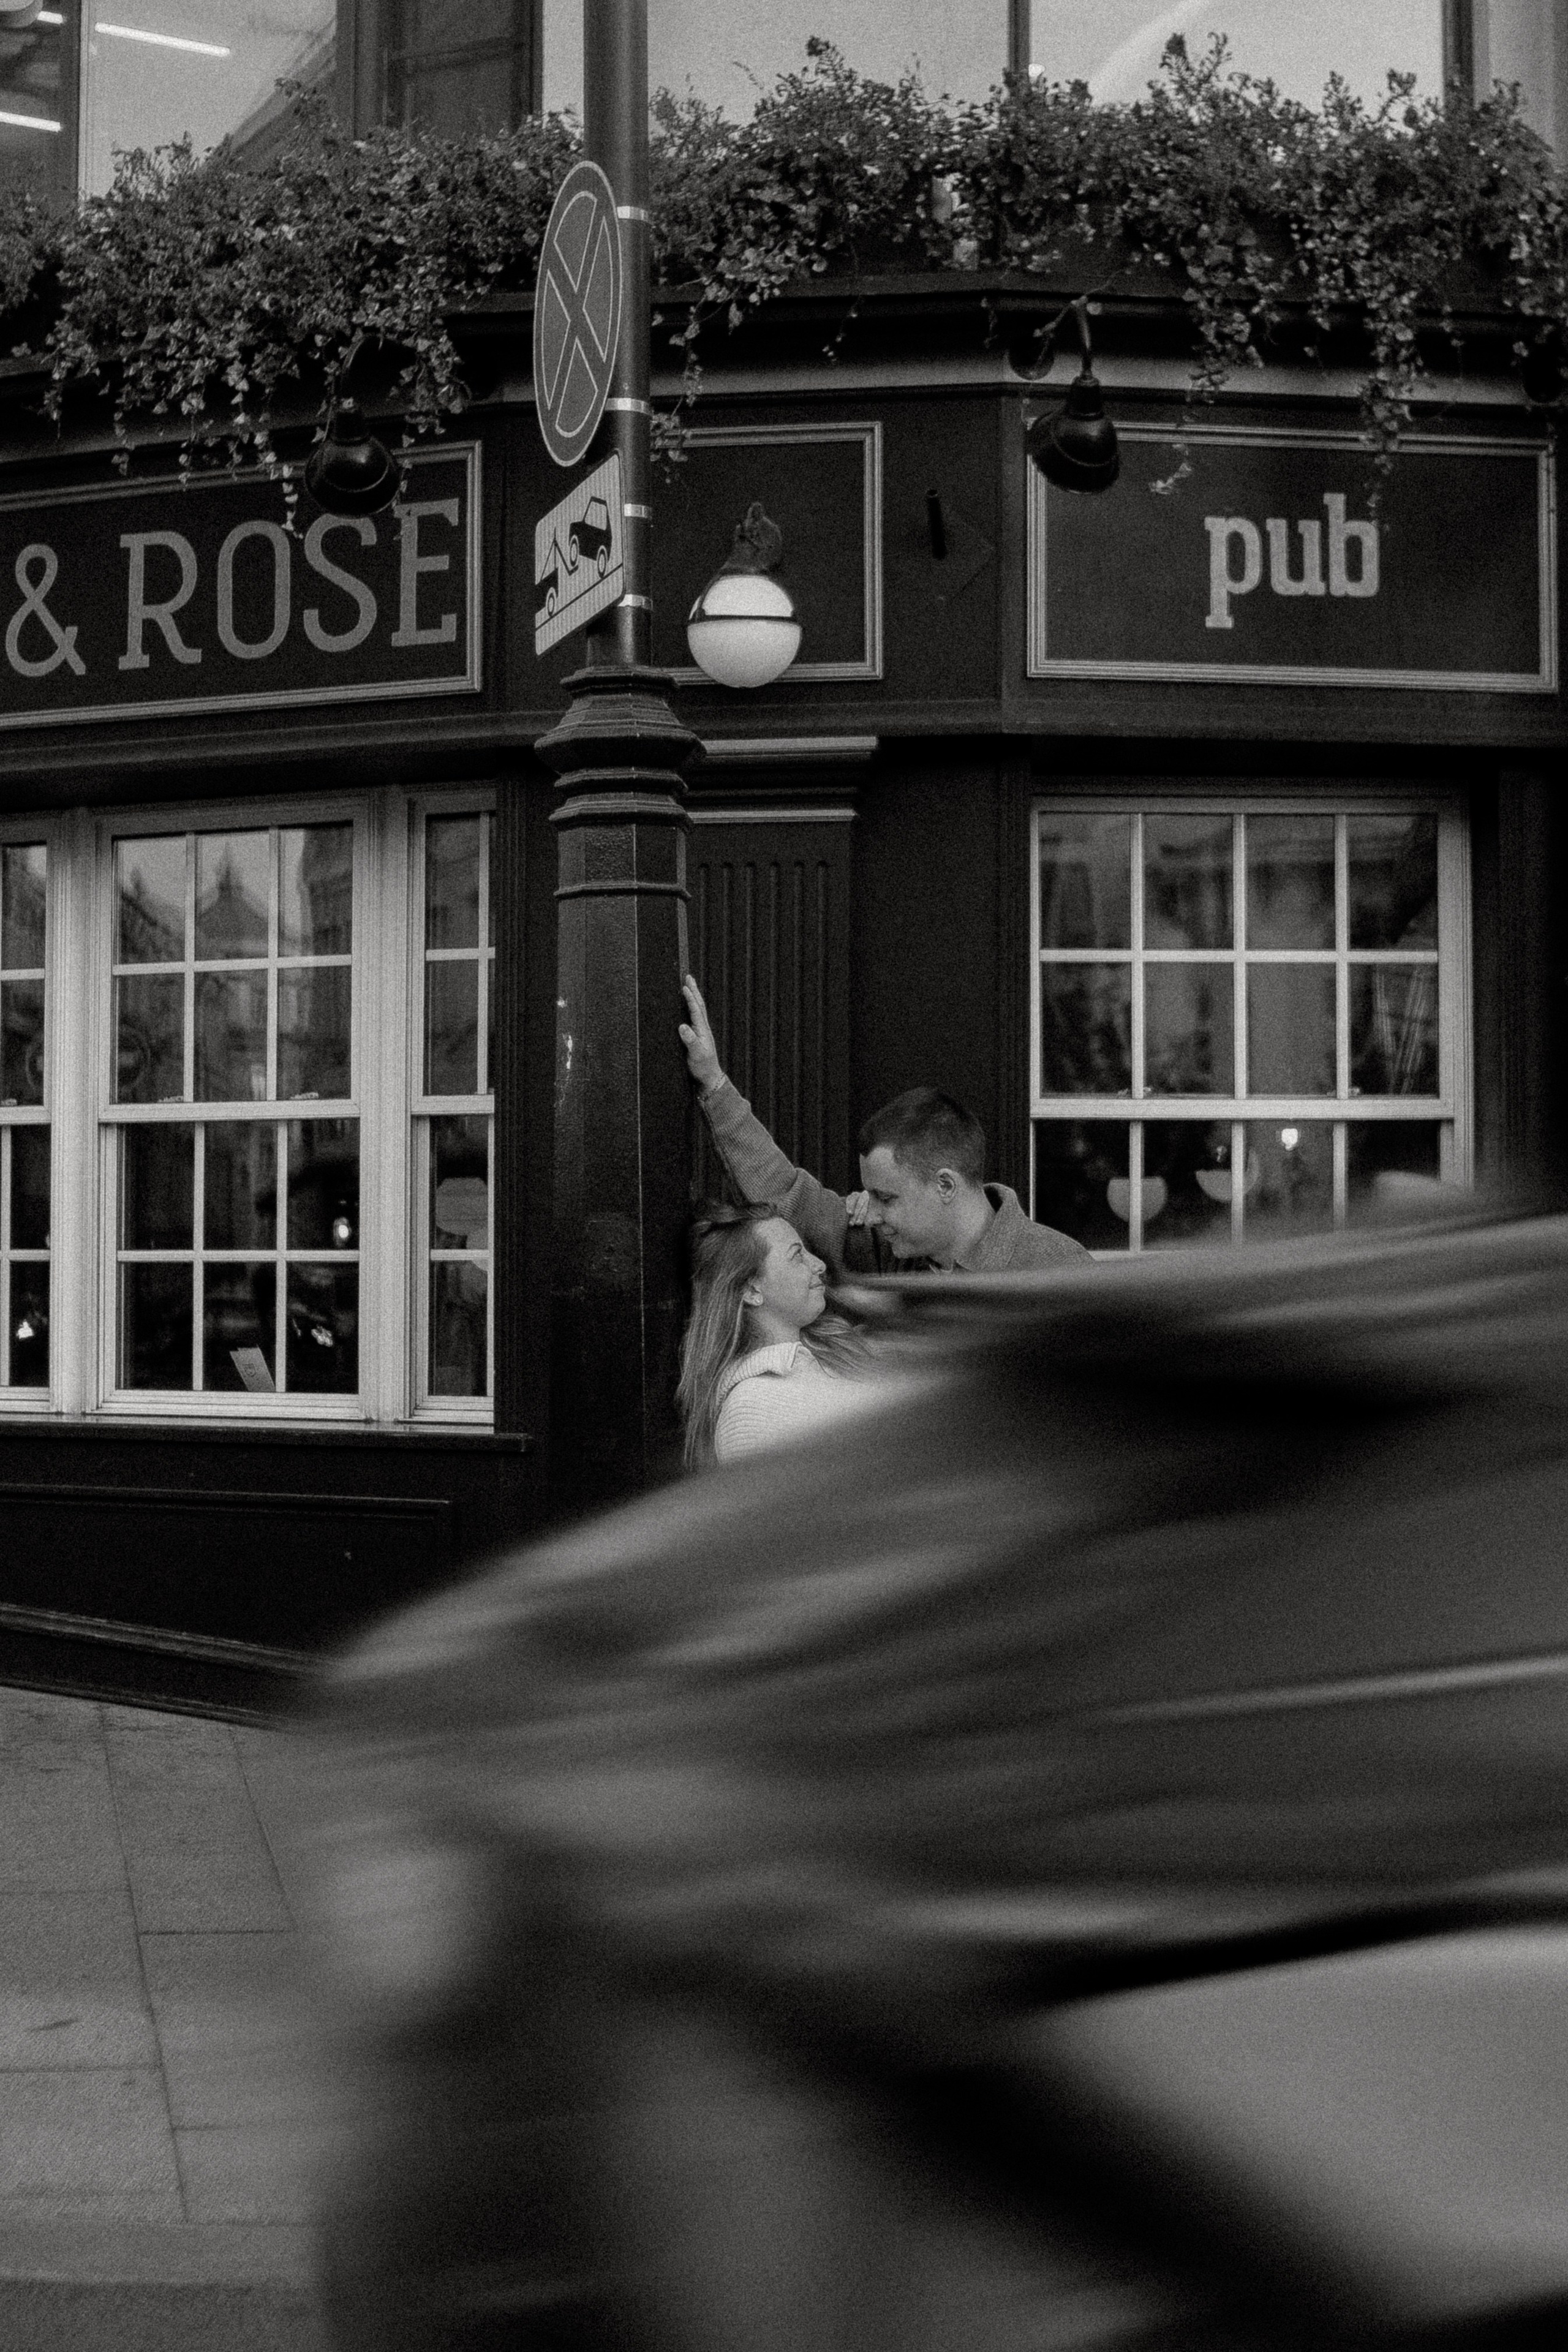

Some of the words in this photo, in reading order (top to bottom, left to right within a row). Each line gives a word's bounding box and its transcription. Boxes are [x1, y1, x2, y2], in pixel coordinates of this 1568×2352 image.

[6, 543, 86, 677] &
[118, 497, 459, 670] ROSE
[1204, 492, 1380, 628] pub
